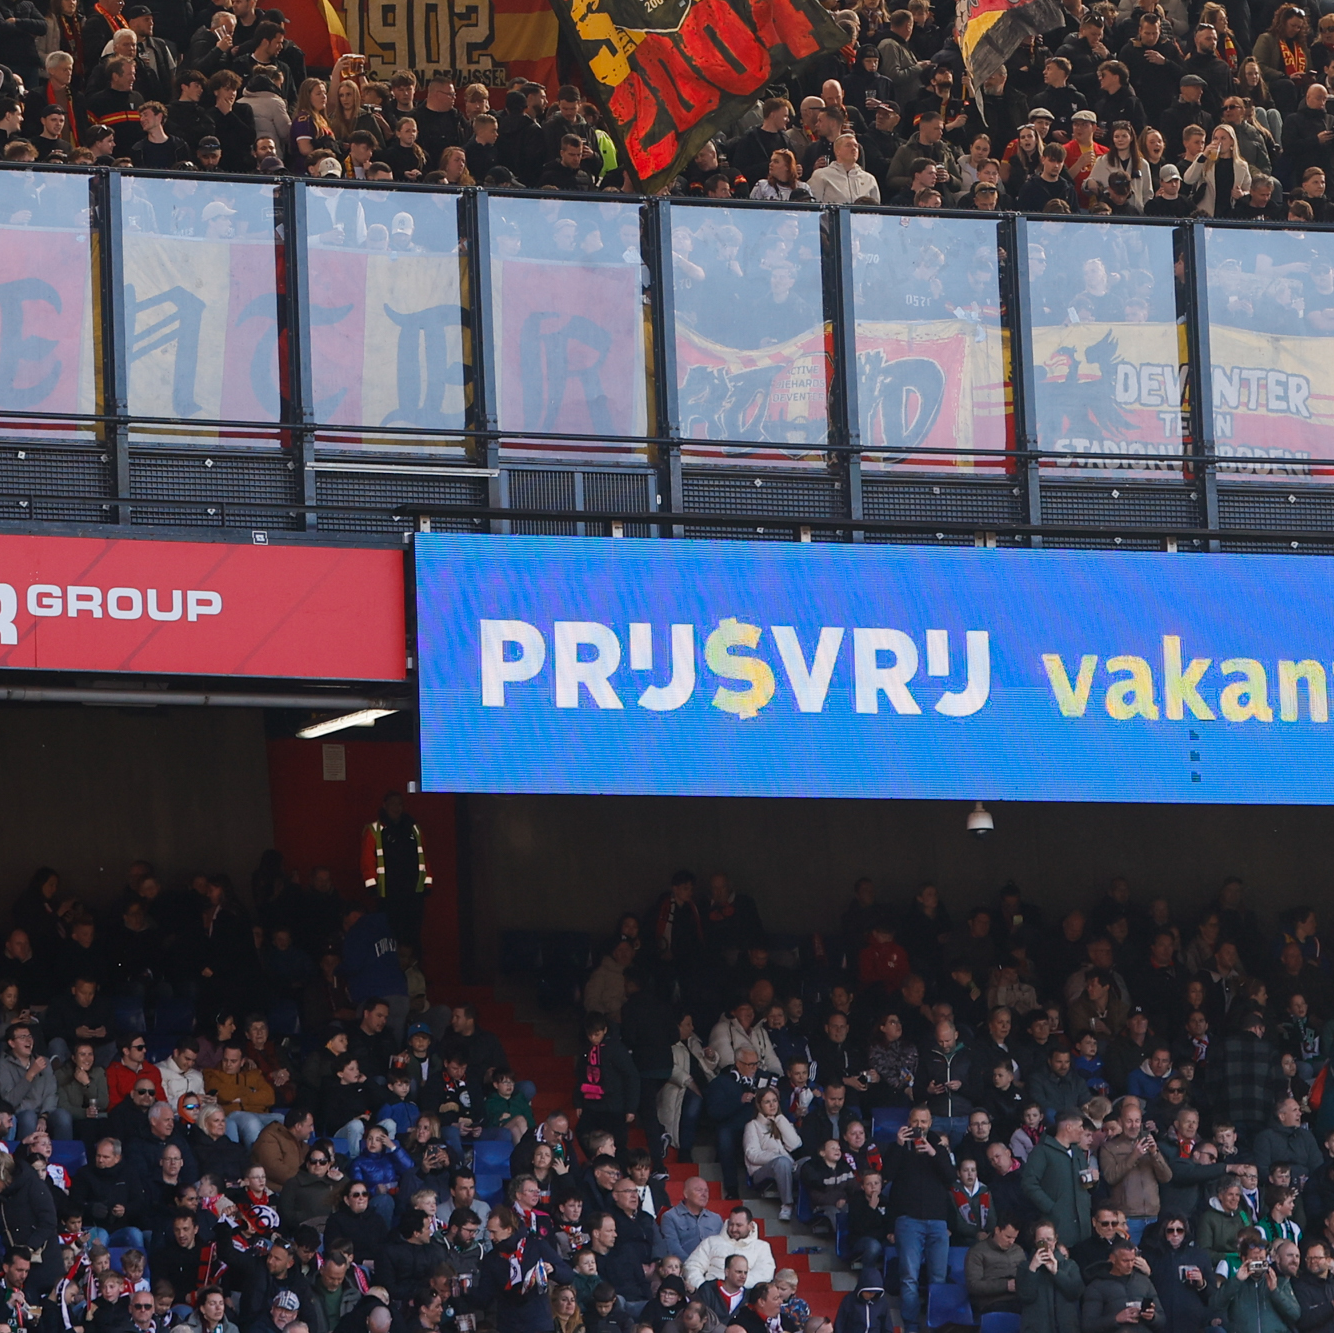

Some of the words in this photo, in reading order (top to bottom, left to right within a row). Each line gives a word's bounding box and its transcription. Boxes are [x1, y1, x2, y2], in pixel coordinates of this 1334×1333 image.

[771, 391, 826, 403] DEVENTER
[1116, 364, 1312, 418] DEVNTER
[27, 584, 222, 622] GROUP
